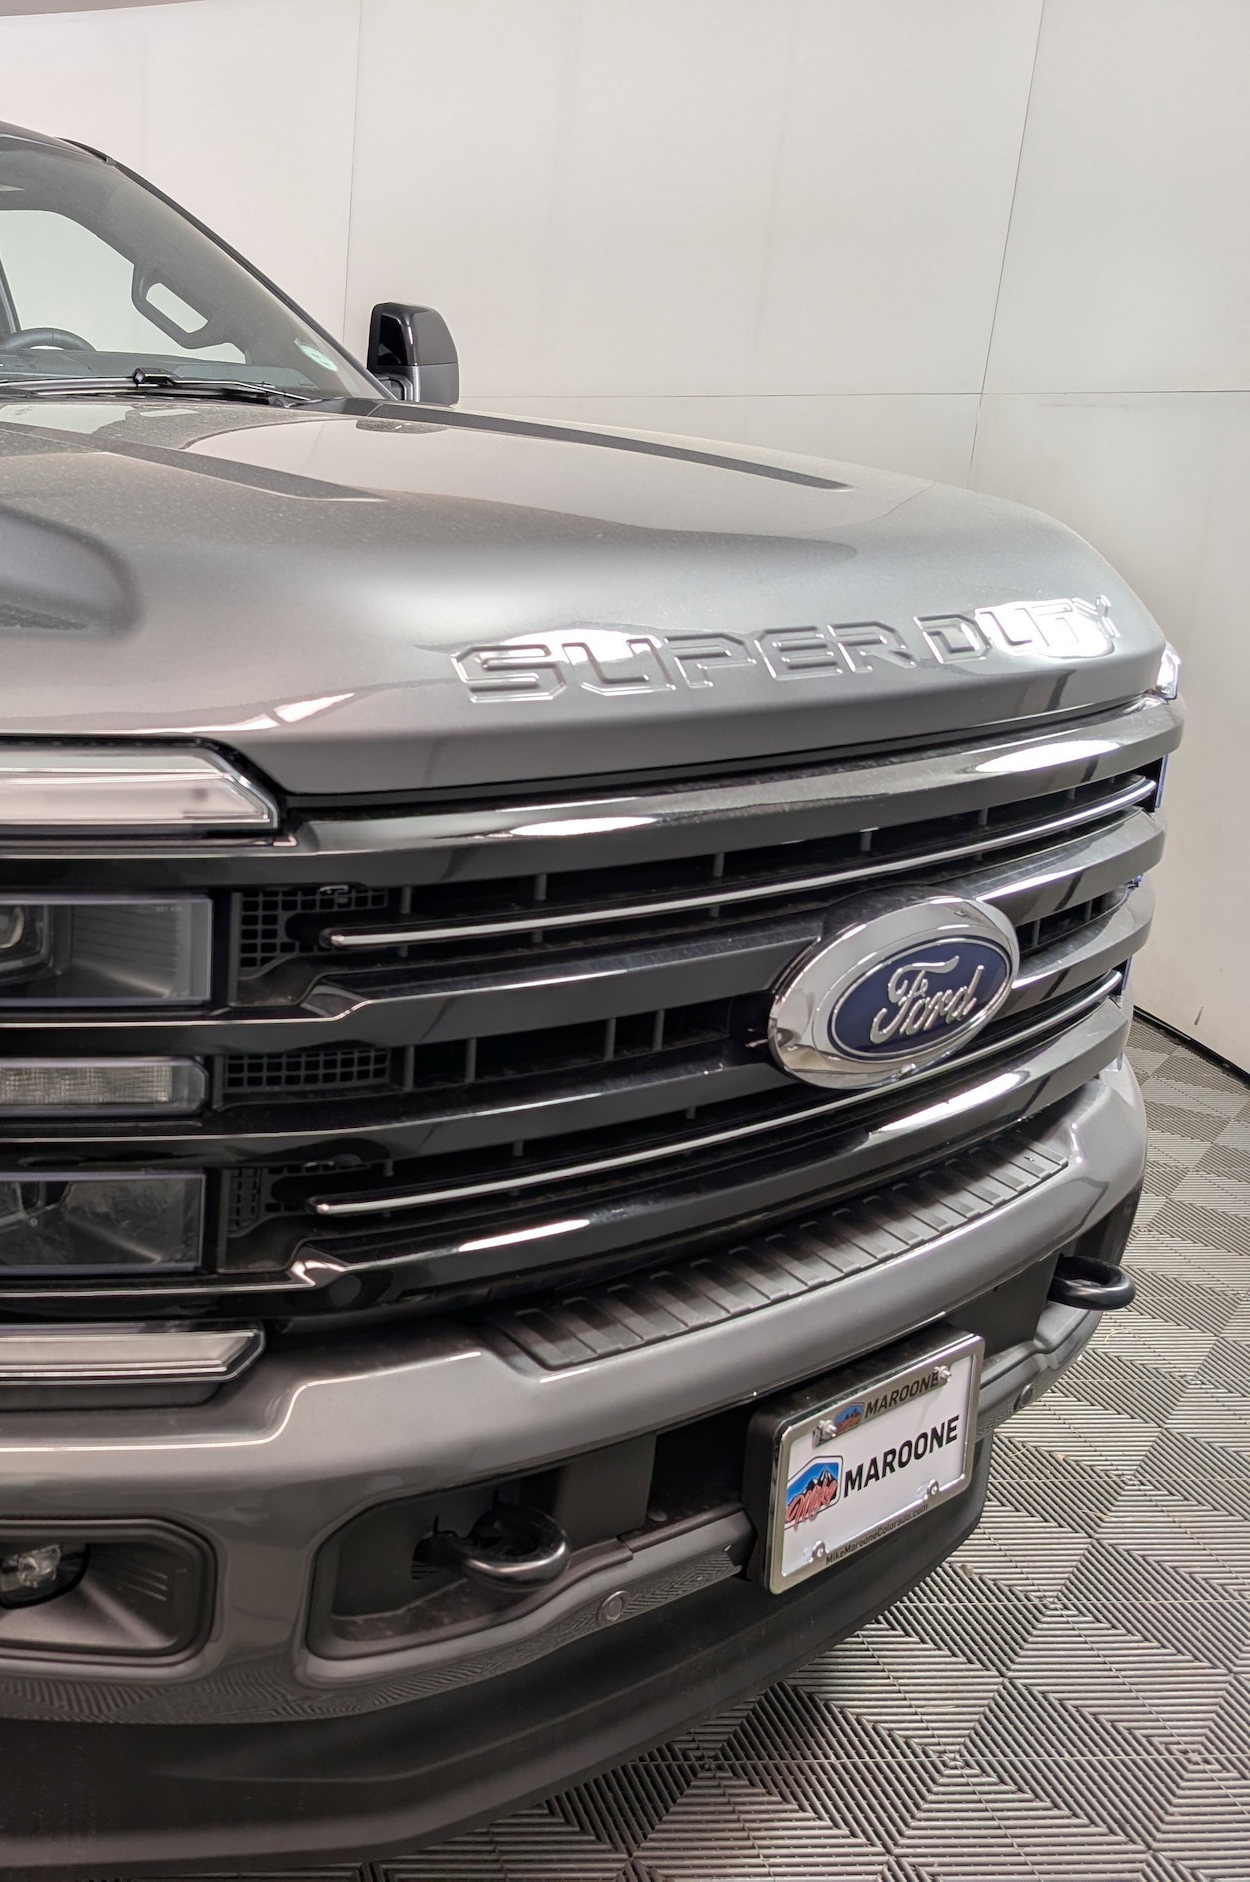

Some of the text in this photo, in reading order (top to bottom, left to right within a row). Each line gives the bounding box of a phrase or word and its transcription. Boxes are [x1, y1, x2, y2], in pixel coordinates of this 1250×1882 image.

[451, 594, 1122, 704] SUPER DUTY
[869, 954, 985, 1045] Ford
[864, 1371, 940, 1419] MAROONE
[843, 1414, 960, 1499] MAROONE
